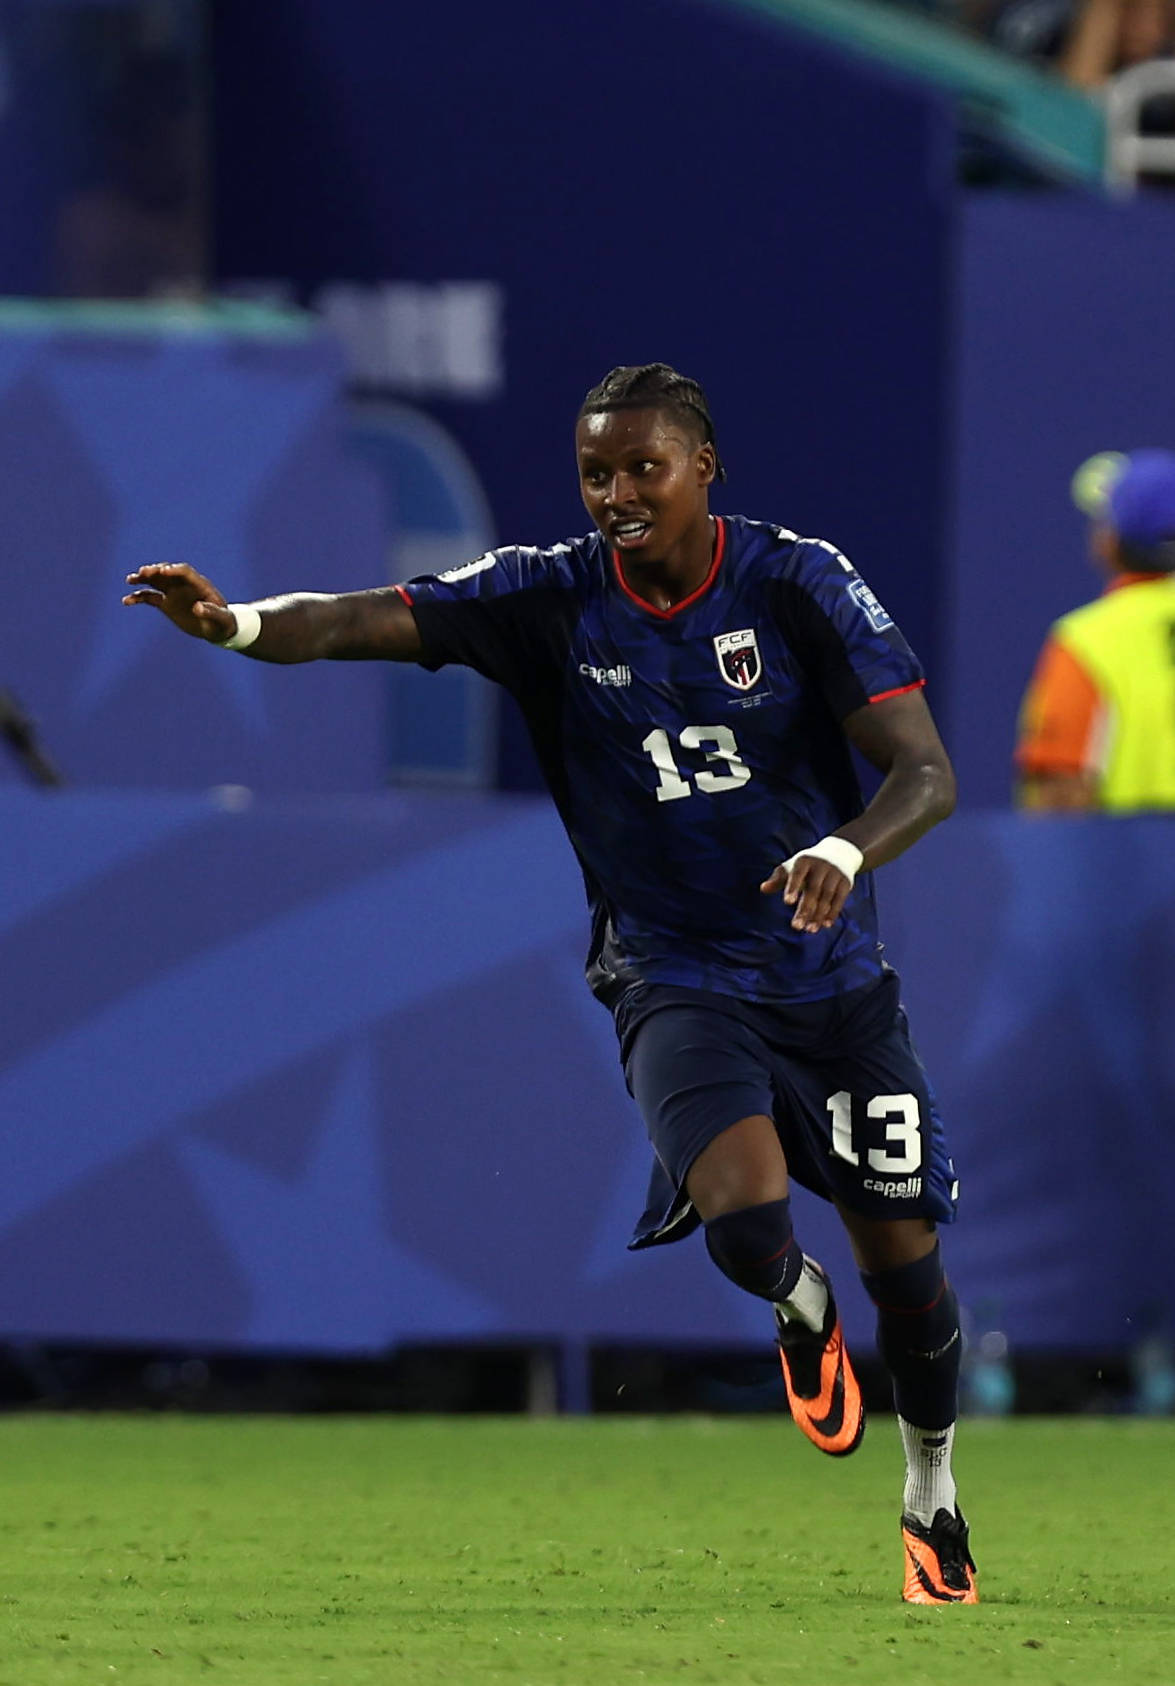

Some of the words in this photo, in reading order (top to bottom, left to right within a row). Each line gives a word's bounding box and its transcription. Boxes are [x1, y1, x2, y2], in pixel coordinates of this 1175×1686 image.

[717, 631, 752, 648] FCF
[579, 663, 631, 684] capelli
[642, 725, 751, 802] 13
[827, 1090, 921, 1173] 13
[864, 1177, 922, 1196] capelli
